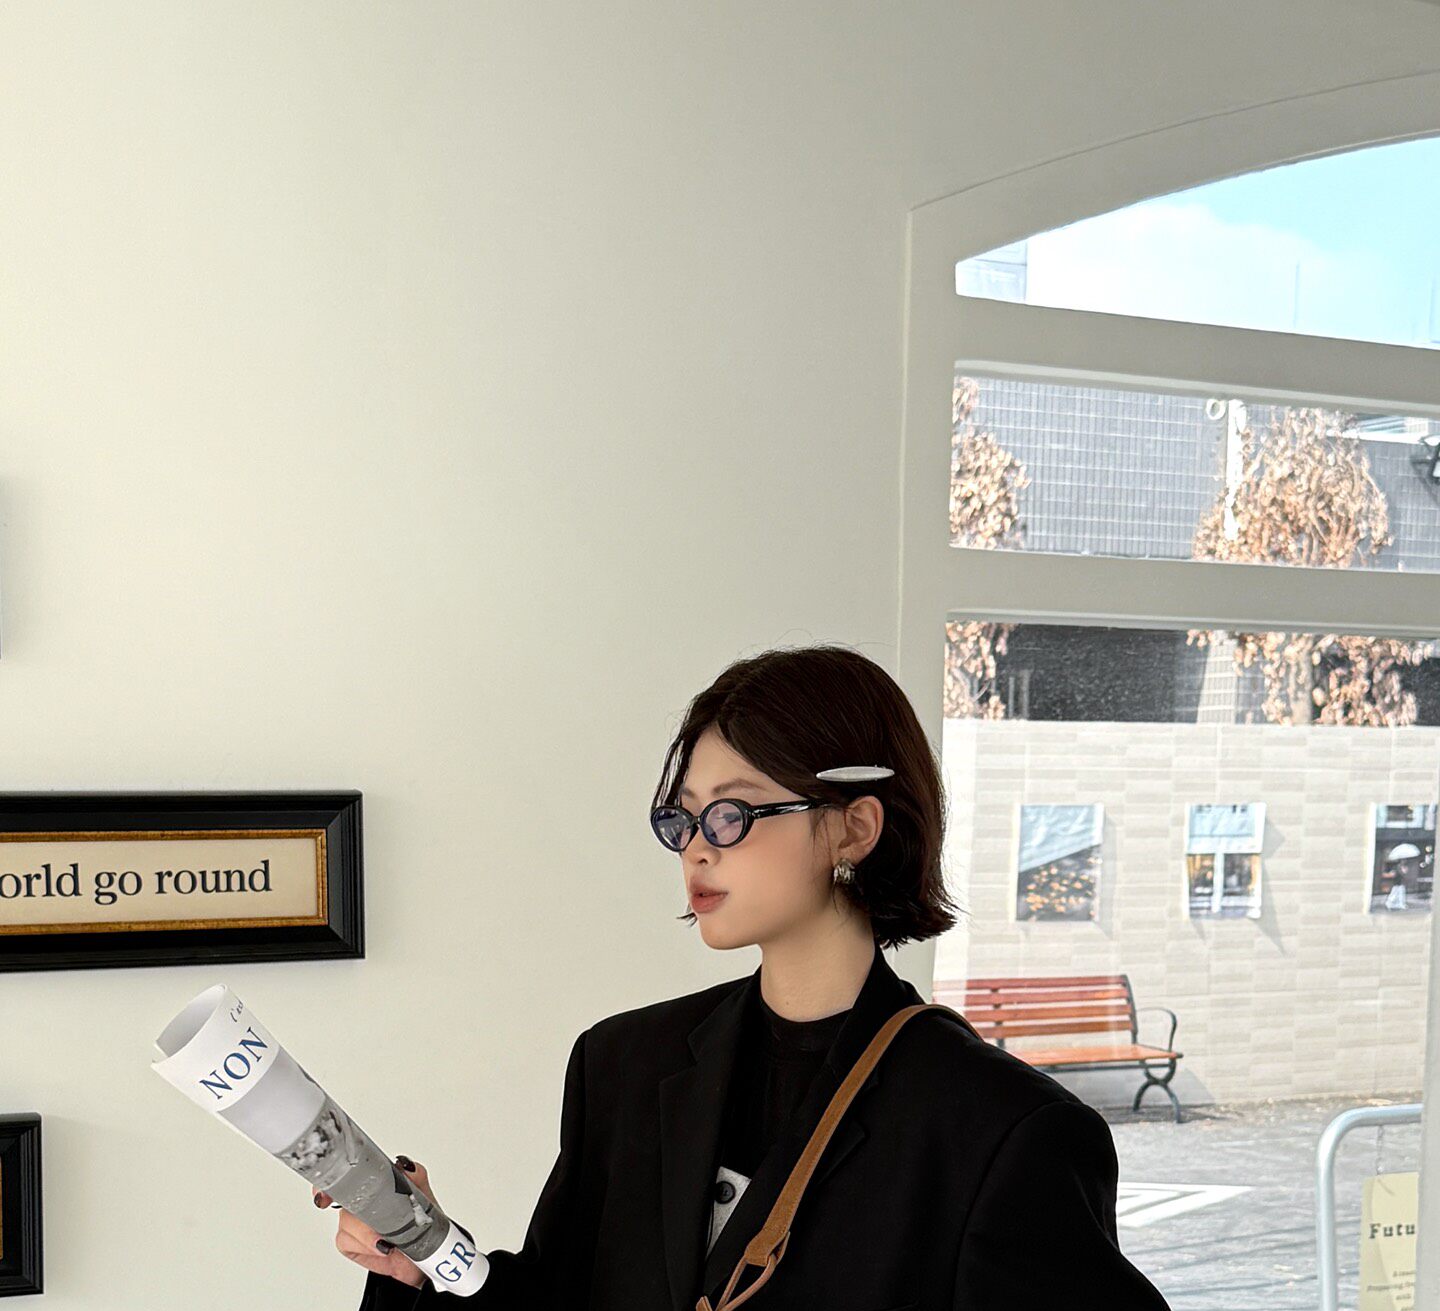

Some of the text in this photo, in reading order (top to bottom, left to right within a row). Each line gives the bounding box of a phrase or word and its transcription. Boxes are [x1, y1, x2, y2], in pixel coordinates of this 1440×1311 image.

[94, 870, 142, 905] go
[155, 859, 272, 895] round
[199, 1027, 269, 1100] NON
[435, 1241, 476, 1282] GR
